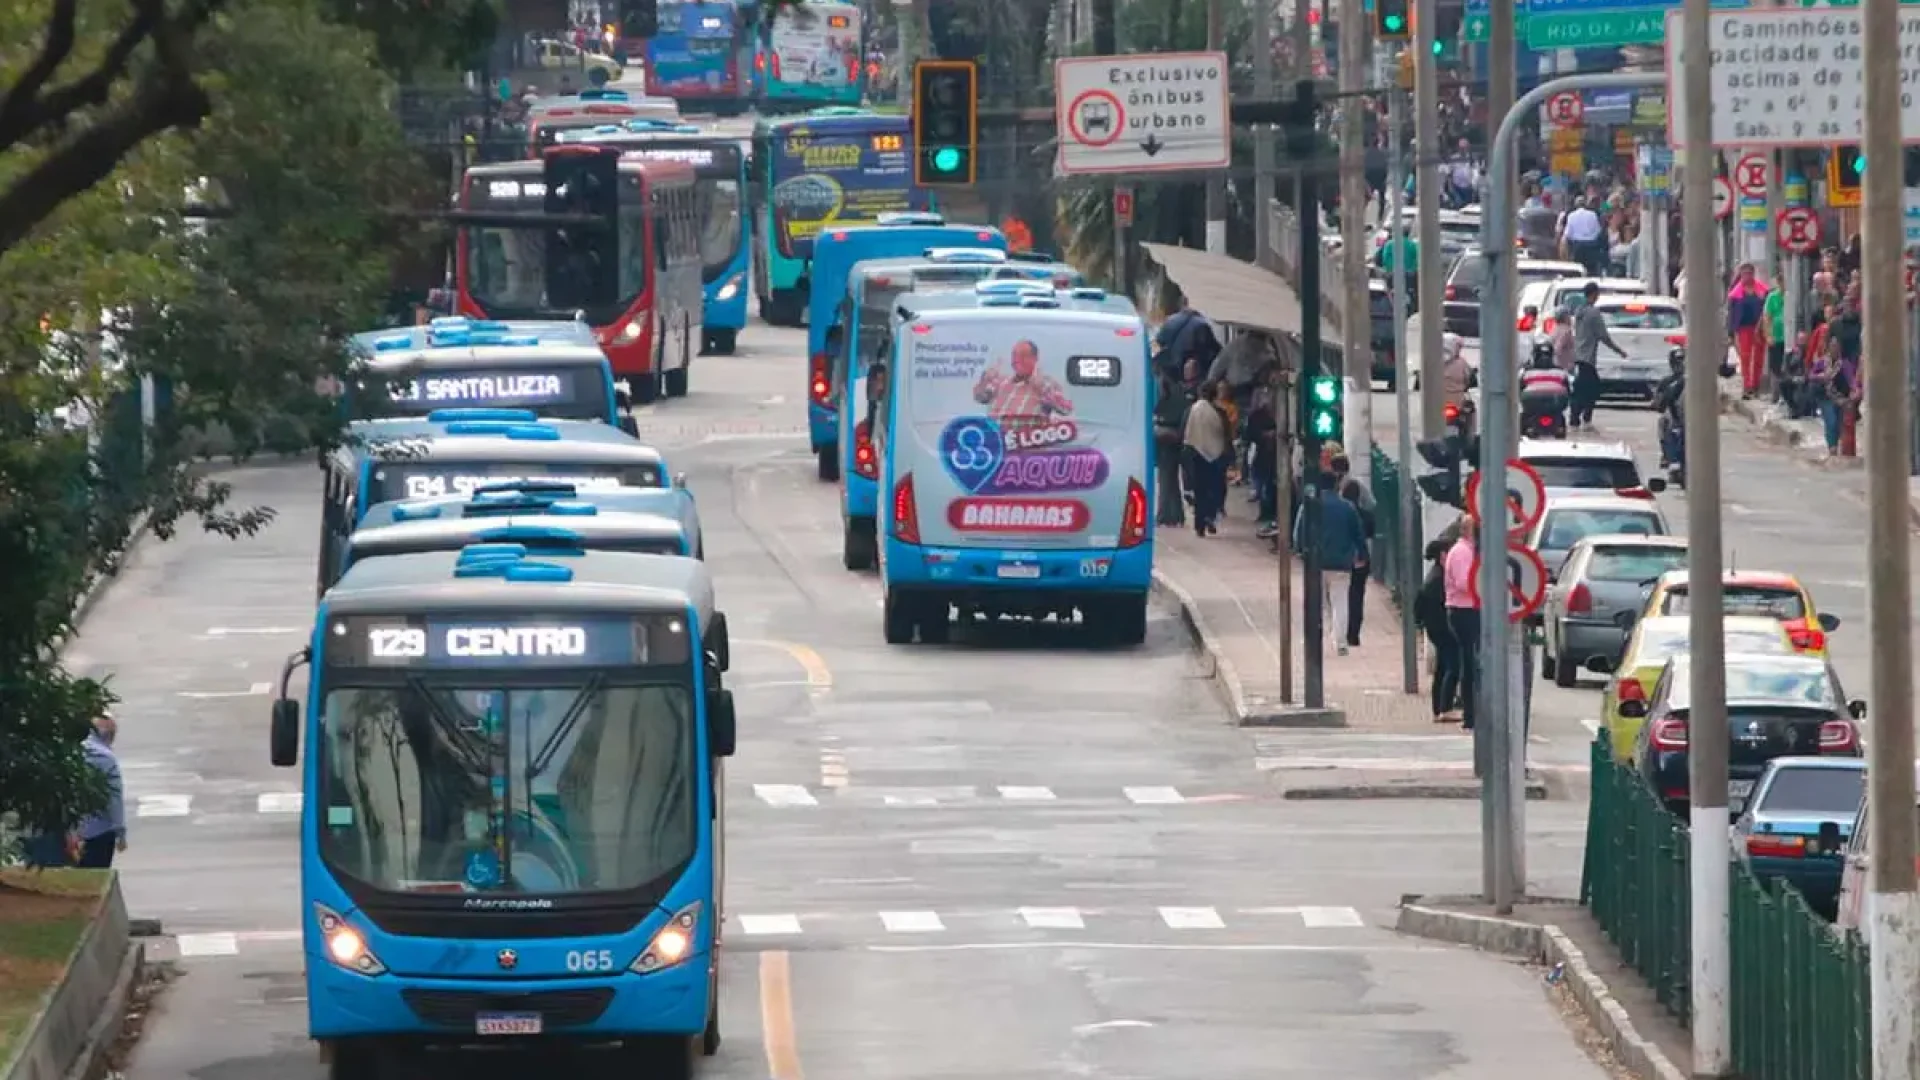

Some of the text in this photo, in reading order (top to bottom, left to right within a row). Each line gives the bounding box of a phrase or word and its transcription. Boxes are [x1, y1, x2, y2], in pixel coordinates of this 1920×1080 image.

[1109, 67, 1218, 83] Exclusivo
[1727, 69, 1800, 87] acima
[1813, 67, 1842, 86] de
[1128, 88, 1204, 105] ônibus
[1130, 113, 1206, 129] urbano
[1078, 359, 1110, 377] 122
[426, 377, 494, 399] SANTA
[497, 375, 560, 397] LUZIA
[1020, 424, 1072, 447] LOGO
[406, 476, 445, 497] 134
[963, 505, 1074, 526] BAHAMAS
[369, 627, 585, 656] 129 CENTRO
[566, 950, 613, 971] 065
